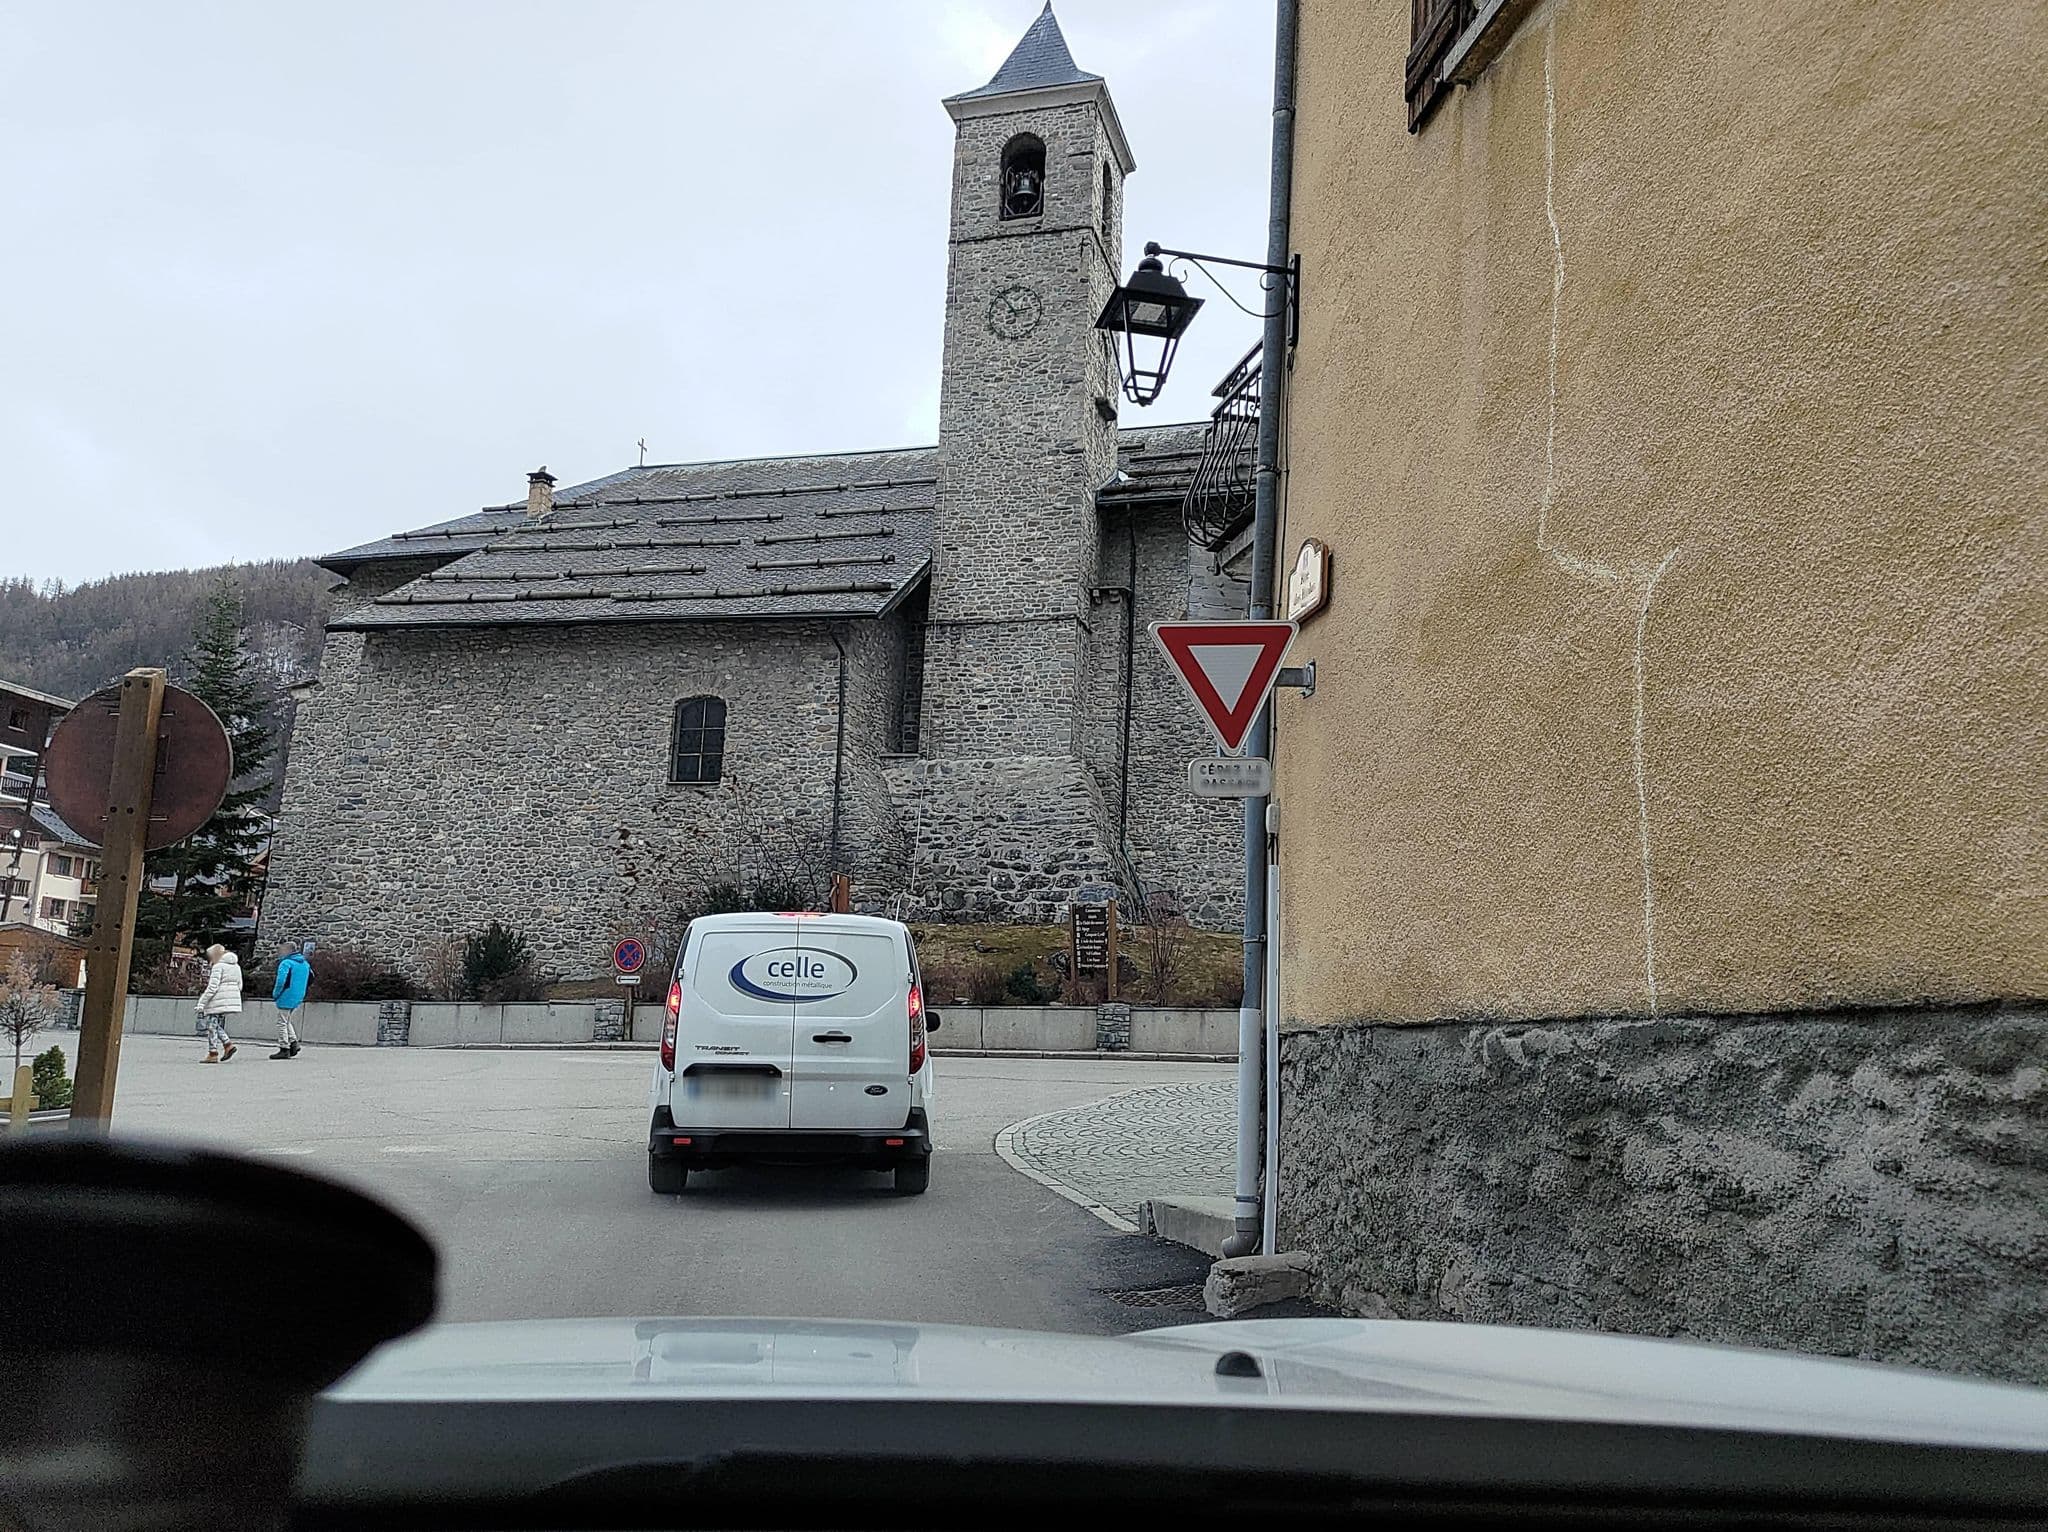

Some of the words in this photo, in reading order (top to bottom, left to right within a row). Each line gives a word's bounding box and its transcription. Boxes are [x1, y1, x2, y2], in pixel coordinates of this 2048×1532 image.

[767, 956, 825, 979] celle
[763, 979, 800, 987] construction
[801, 980, 833, 989] métallique
